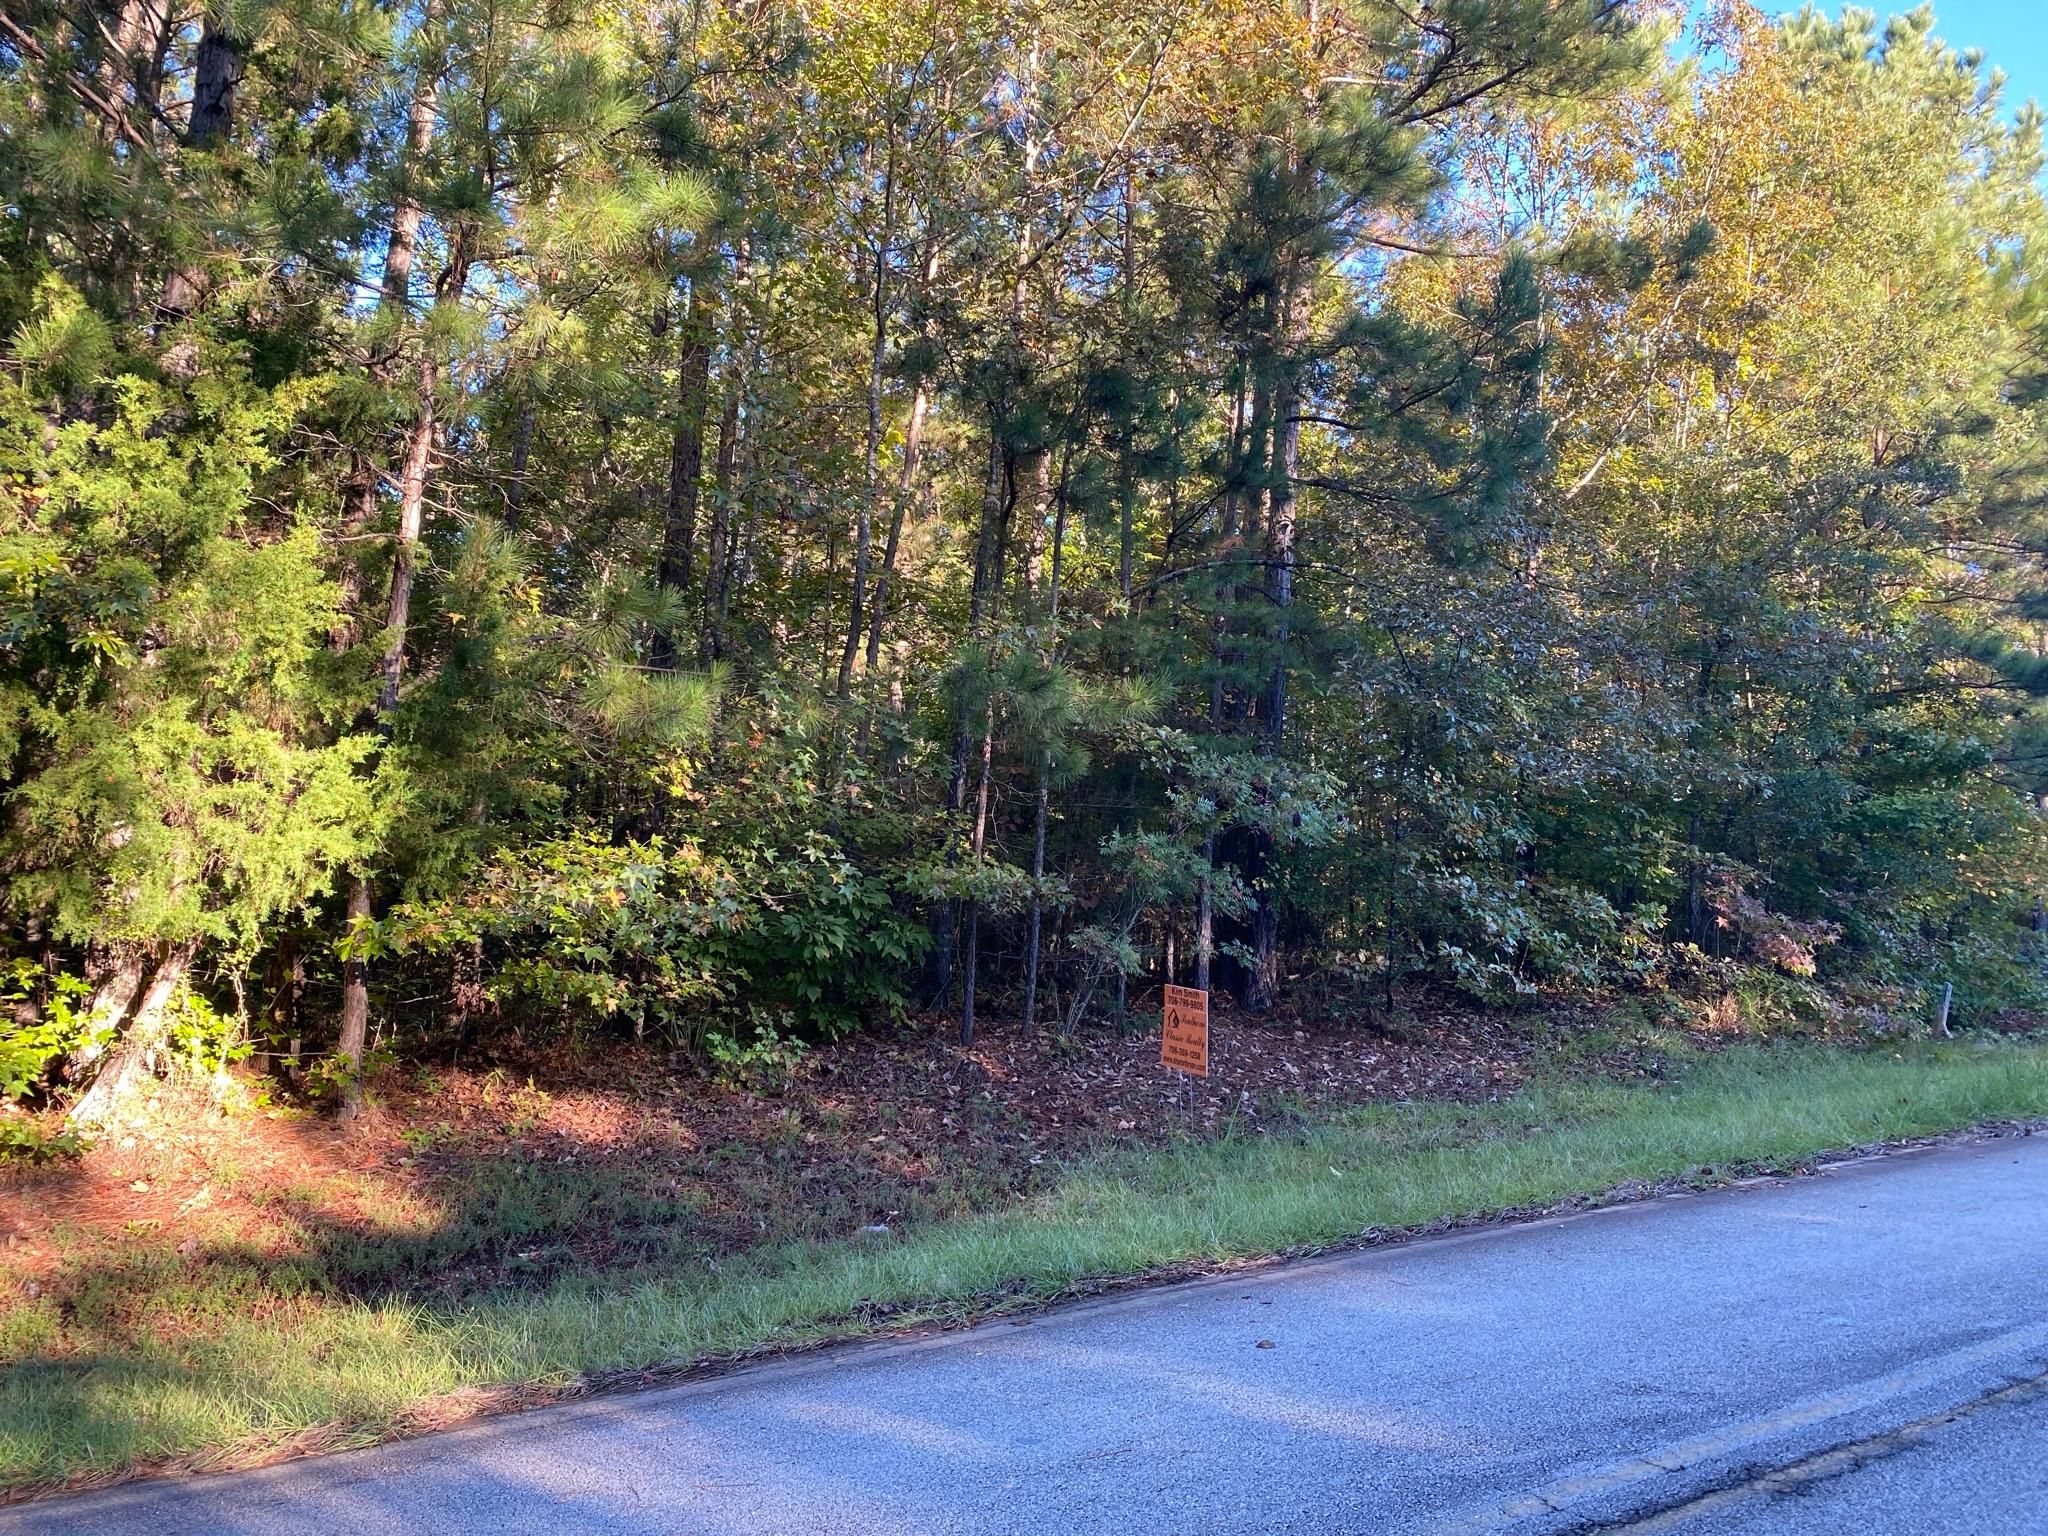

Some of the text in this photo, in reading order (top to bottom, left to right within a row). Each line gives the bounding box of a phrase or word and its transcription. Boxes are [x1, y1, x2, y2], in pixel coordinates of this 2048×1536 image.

[1172, 987, 1199, 1000] Kim Smith
[1166, 1029, 1205, 1050] Classic Realty
